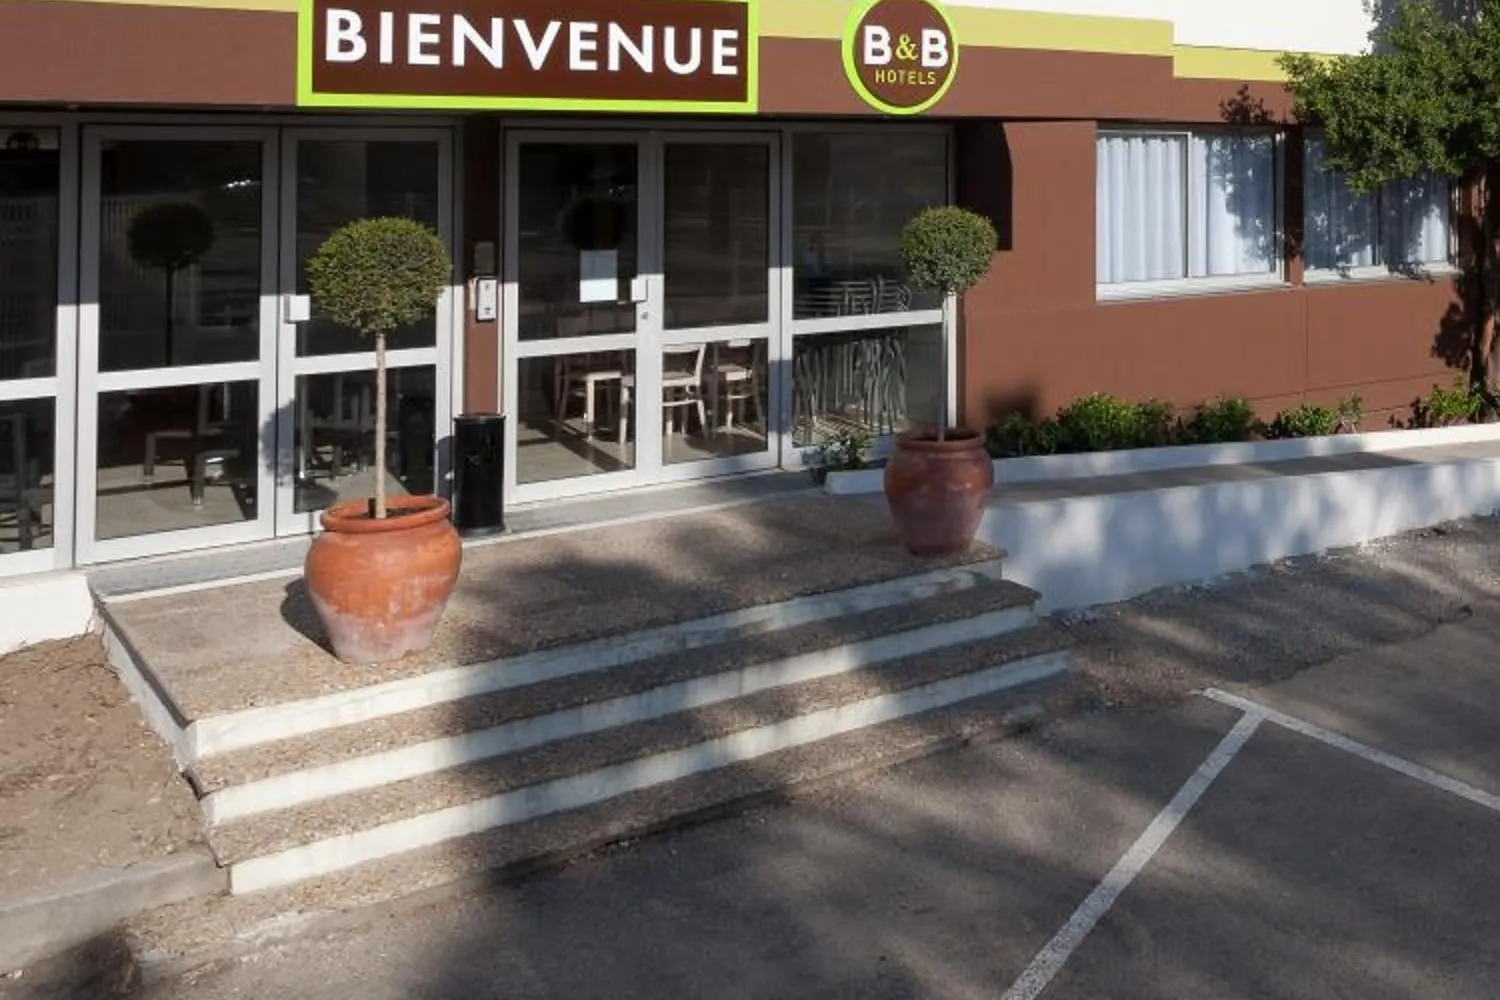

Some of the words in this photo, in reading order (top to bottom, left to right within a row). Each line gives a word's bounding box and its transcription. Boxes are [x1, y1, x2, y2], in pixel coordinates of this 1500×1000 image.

[324, 8, 740, 76] BIENVENUE
[863, 24, 949, 68] B&B
[875, 68, 937, 85] HOTELS
